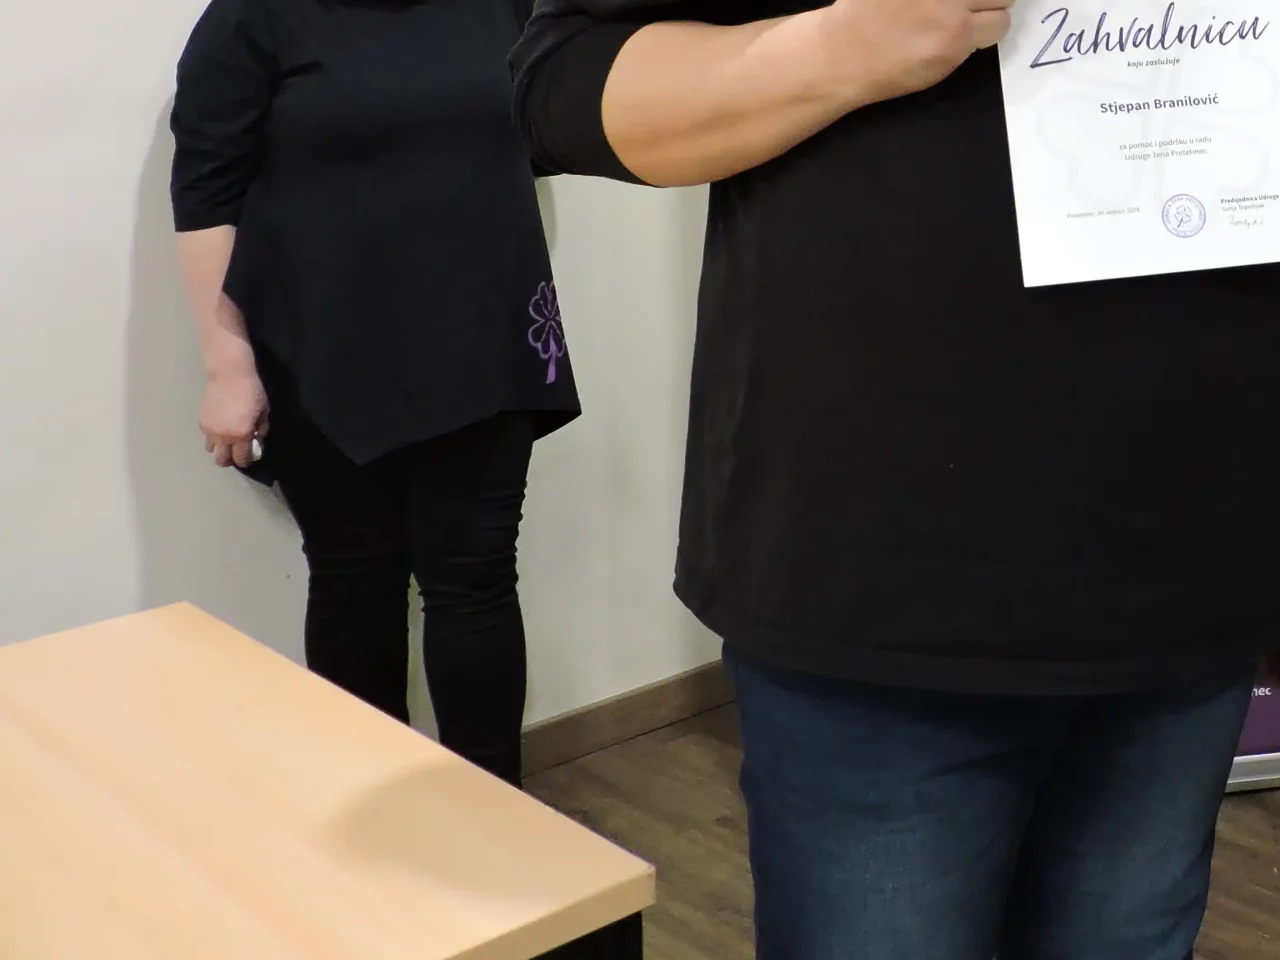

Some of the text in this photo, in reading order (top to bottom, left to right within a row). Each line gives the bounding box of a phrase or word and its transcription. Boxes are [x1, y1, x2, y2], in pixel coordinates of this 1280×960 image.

[1127, 56, 1181, 68] koju zaslužuje
[1100, 93, 1219, 115] Stjepan Branilović
[1128, 140, 1153, 150] pomoć
[1195, 135, 1212, 144] radu
[1124, 152, 1151, 161] Udruge
